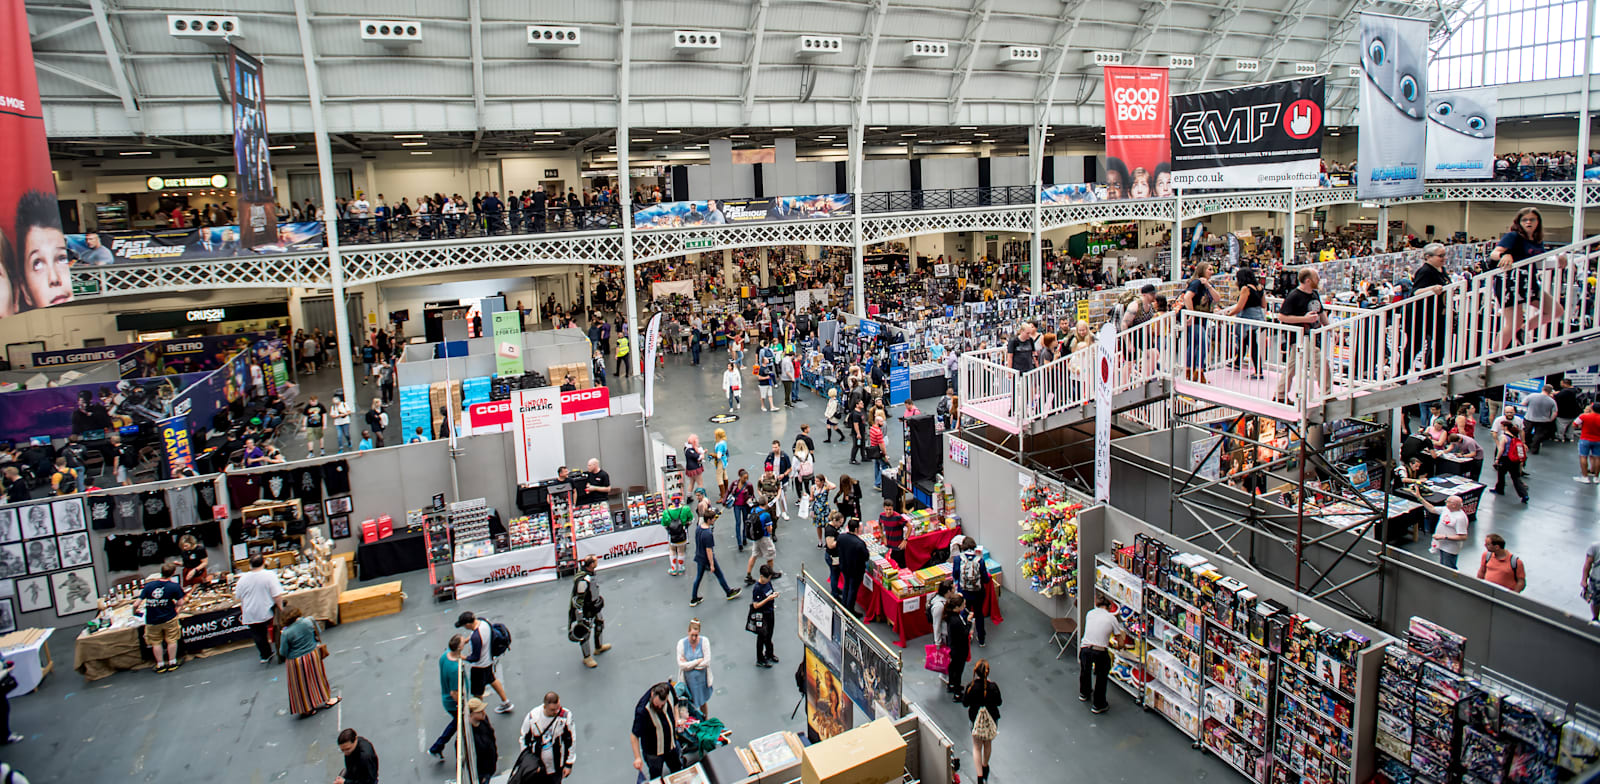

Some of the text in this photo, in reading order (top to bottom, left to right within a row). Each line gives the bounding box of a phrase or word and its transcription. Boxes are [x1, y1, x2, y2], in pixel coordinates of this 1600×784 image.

[1114, 87, 1160, 104] GOOD
[1118, 104, 1157, 121] BOYS
[1174, 102, 1282, 147] EMP
[1173, 171, 1224, 185] emp.co.uk
[1257, 171, 1320, 184] @empukofficial
[723, 205, 746, 213] FAST
[731, 210, 767, 219] FURIOUS
[111, 239, 151, 250] FAST
[124, 245, 186, 259] FURIOUS
[166, 342, 204, 352] RETRO
[38, 350, 116, 365] LAN GAMING
[560, 390, 602, 403] ORDS
[476, 402, 512, 415] COB
[519, 403, 553, 413] GAMING
[175, 429, 194, 469] RETR
[603, 546, 644, 560] GAMING
[609, 541, 638, 554] UNDEAD
[483, 570, 528, 584] GAMING
[490, 564, 521, 578] UNDEAD
[181, 620, 218, 638] HORNS
[221, 615, 236, 628] OF
